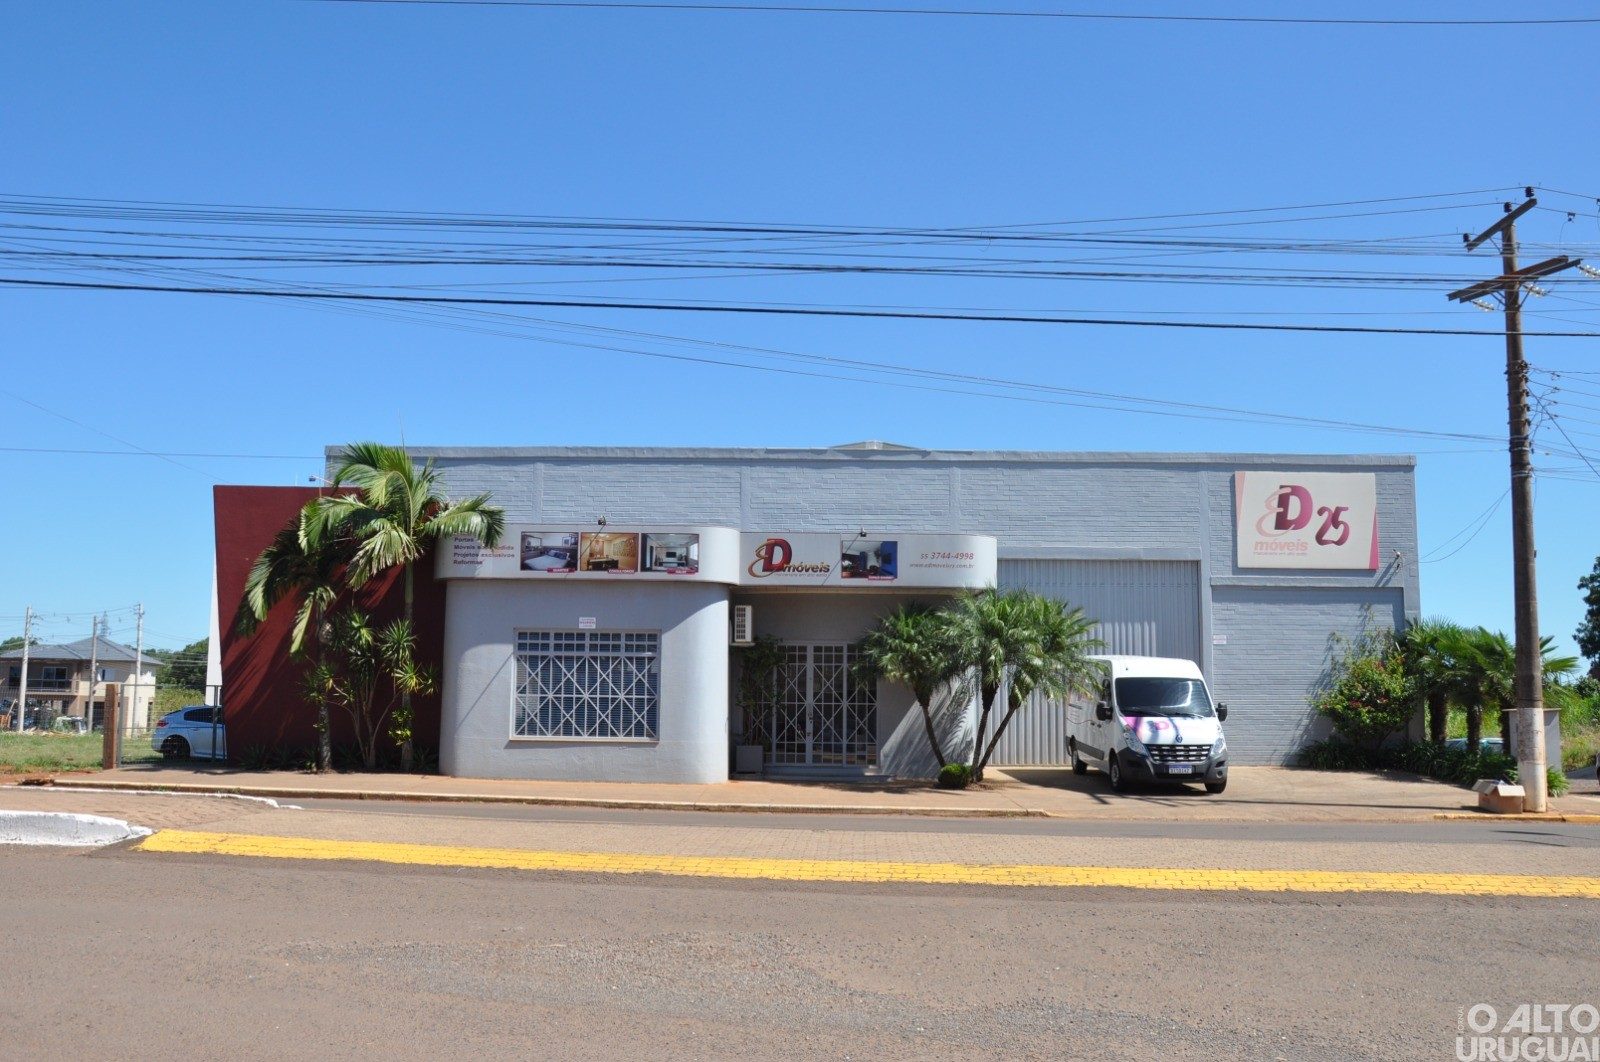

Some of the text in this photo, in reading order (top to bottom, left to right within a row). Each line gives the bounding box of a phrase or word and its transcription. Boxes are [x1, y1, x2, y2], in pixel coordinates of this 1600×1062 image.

[1315, 506, 1350, 546] 25
[930, 552, 974, 560] 3744-4998
[783, 562, 830, 573] móveis
